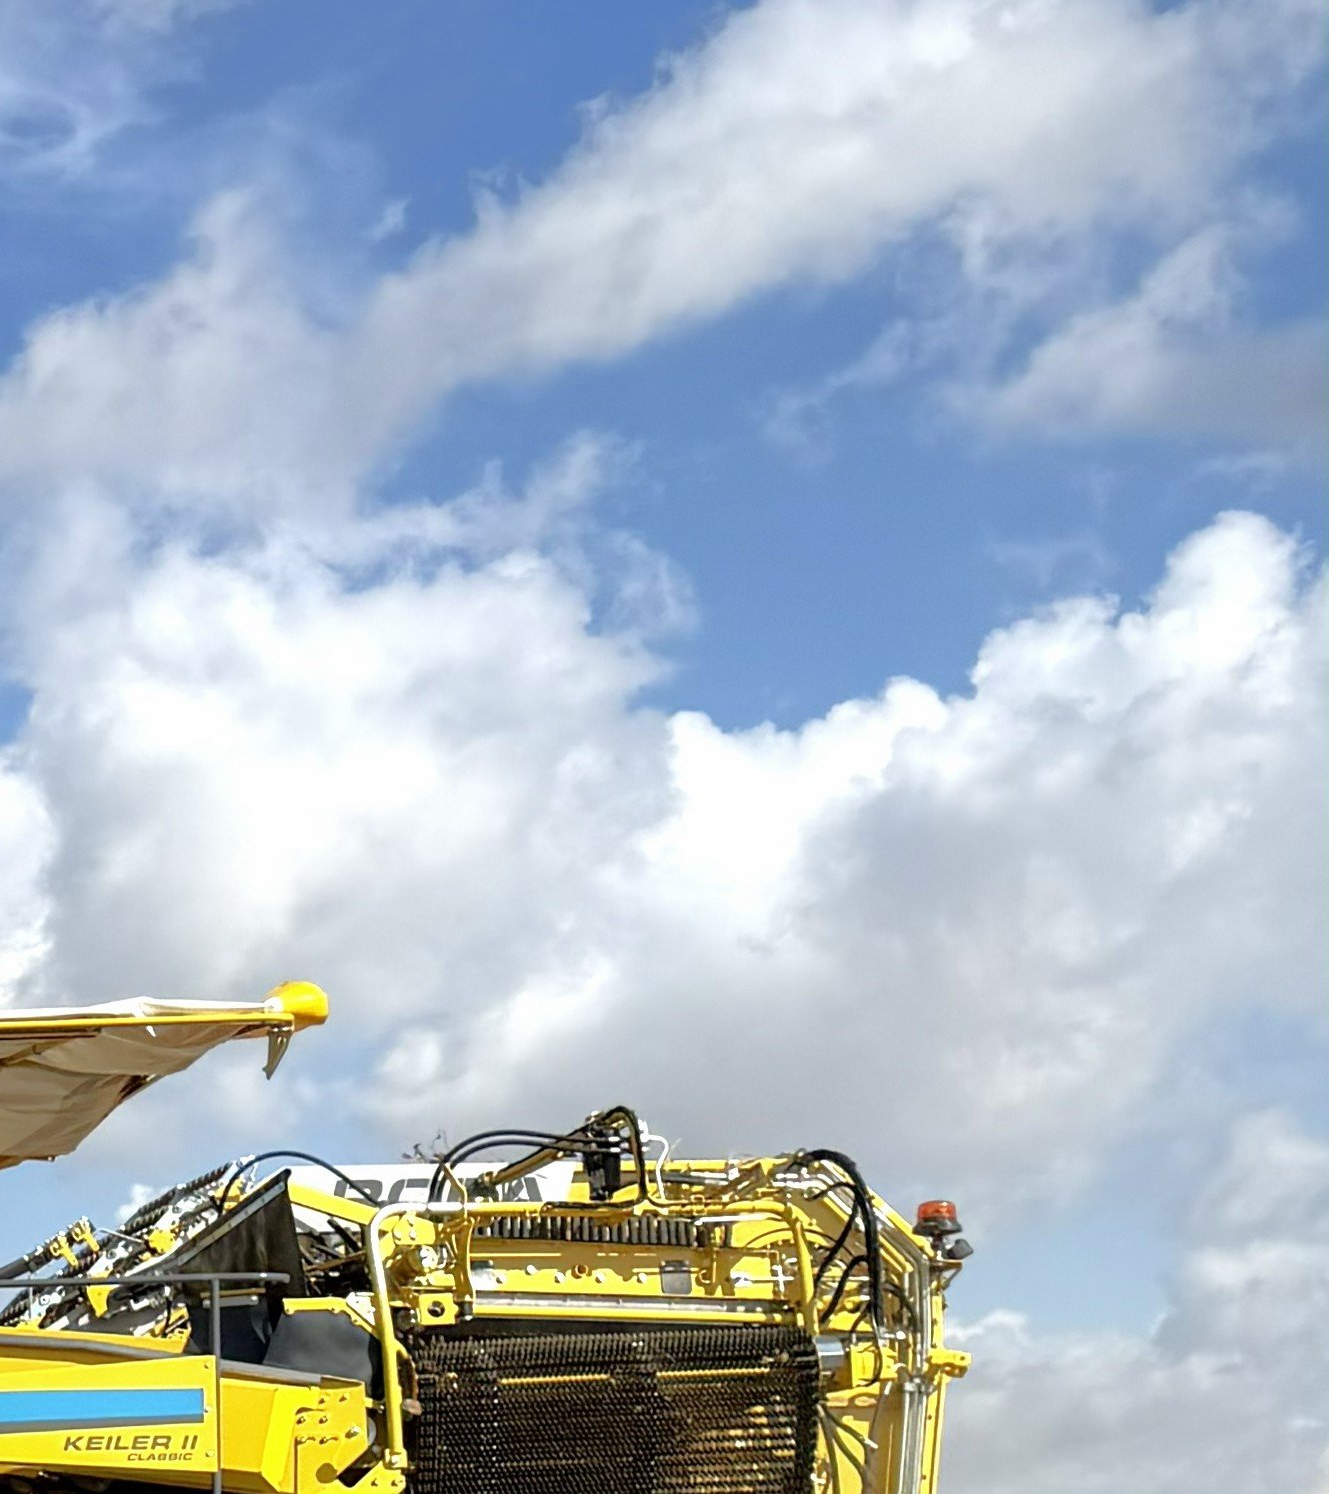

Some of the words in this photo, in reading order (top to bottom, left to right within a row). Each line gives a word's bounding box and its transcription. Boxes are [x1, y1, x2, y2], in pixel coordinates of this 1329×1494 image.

[334, 1177, 543, 1203] ROA
[63, 1435, 172, 1451] KEILER
[181, 1435, 199, 1450] II
[127, 1453, 193, 1461] CLASSIC
